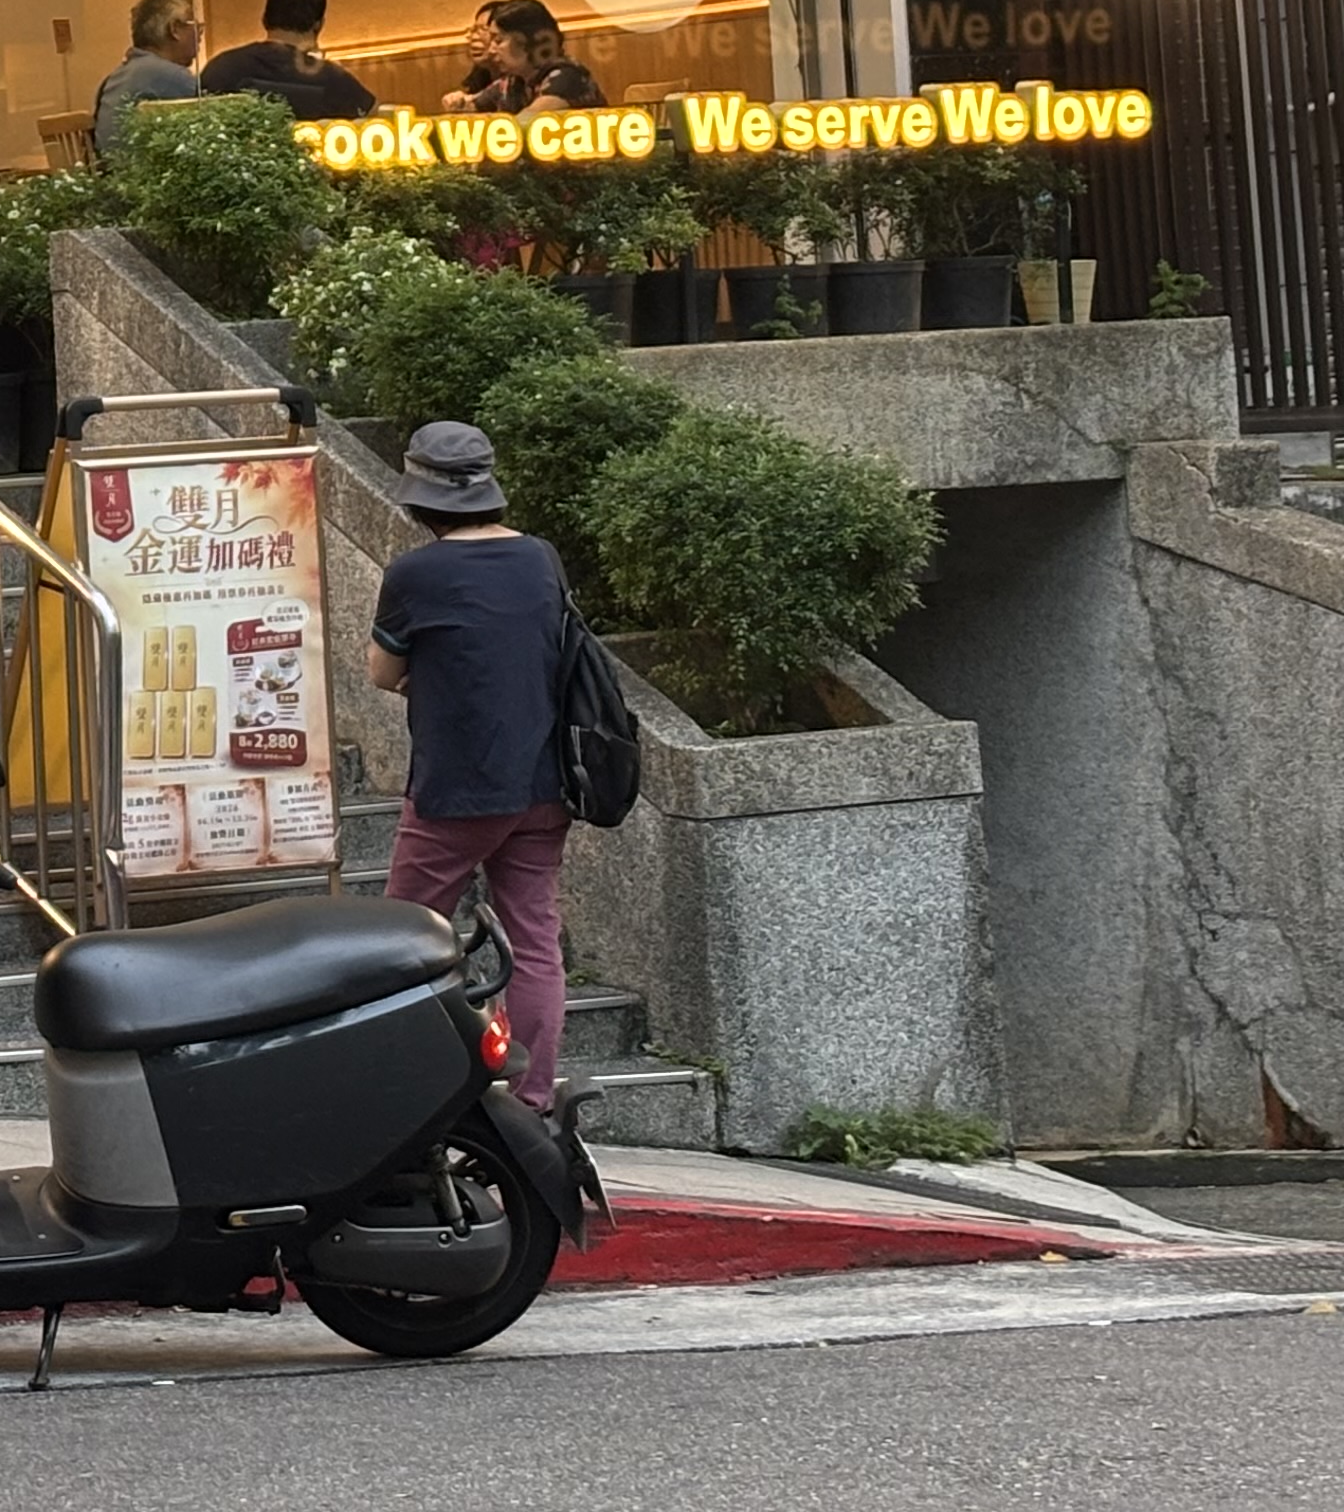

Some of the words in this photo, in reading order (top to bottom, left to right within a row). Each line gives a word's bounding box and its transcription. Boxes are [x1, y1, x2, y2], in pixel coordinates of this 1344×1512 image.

[436, 113, 521, 163] we
[527, 109, 654, 159] care
[684, 92, 778, 153] We
[781, 99, 938, 151] serve
[939, 85, 1029, 144] We
[1034, 85, 1152, 141] love
[166, 484, 240, 531] 雙月
[124, 527, 296, 577] 金運加碼禮
[254, 733, 299, 751] 2,880
